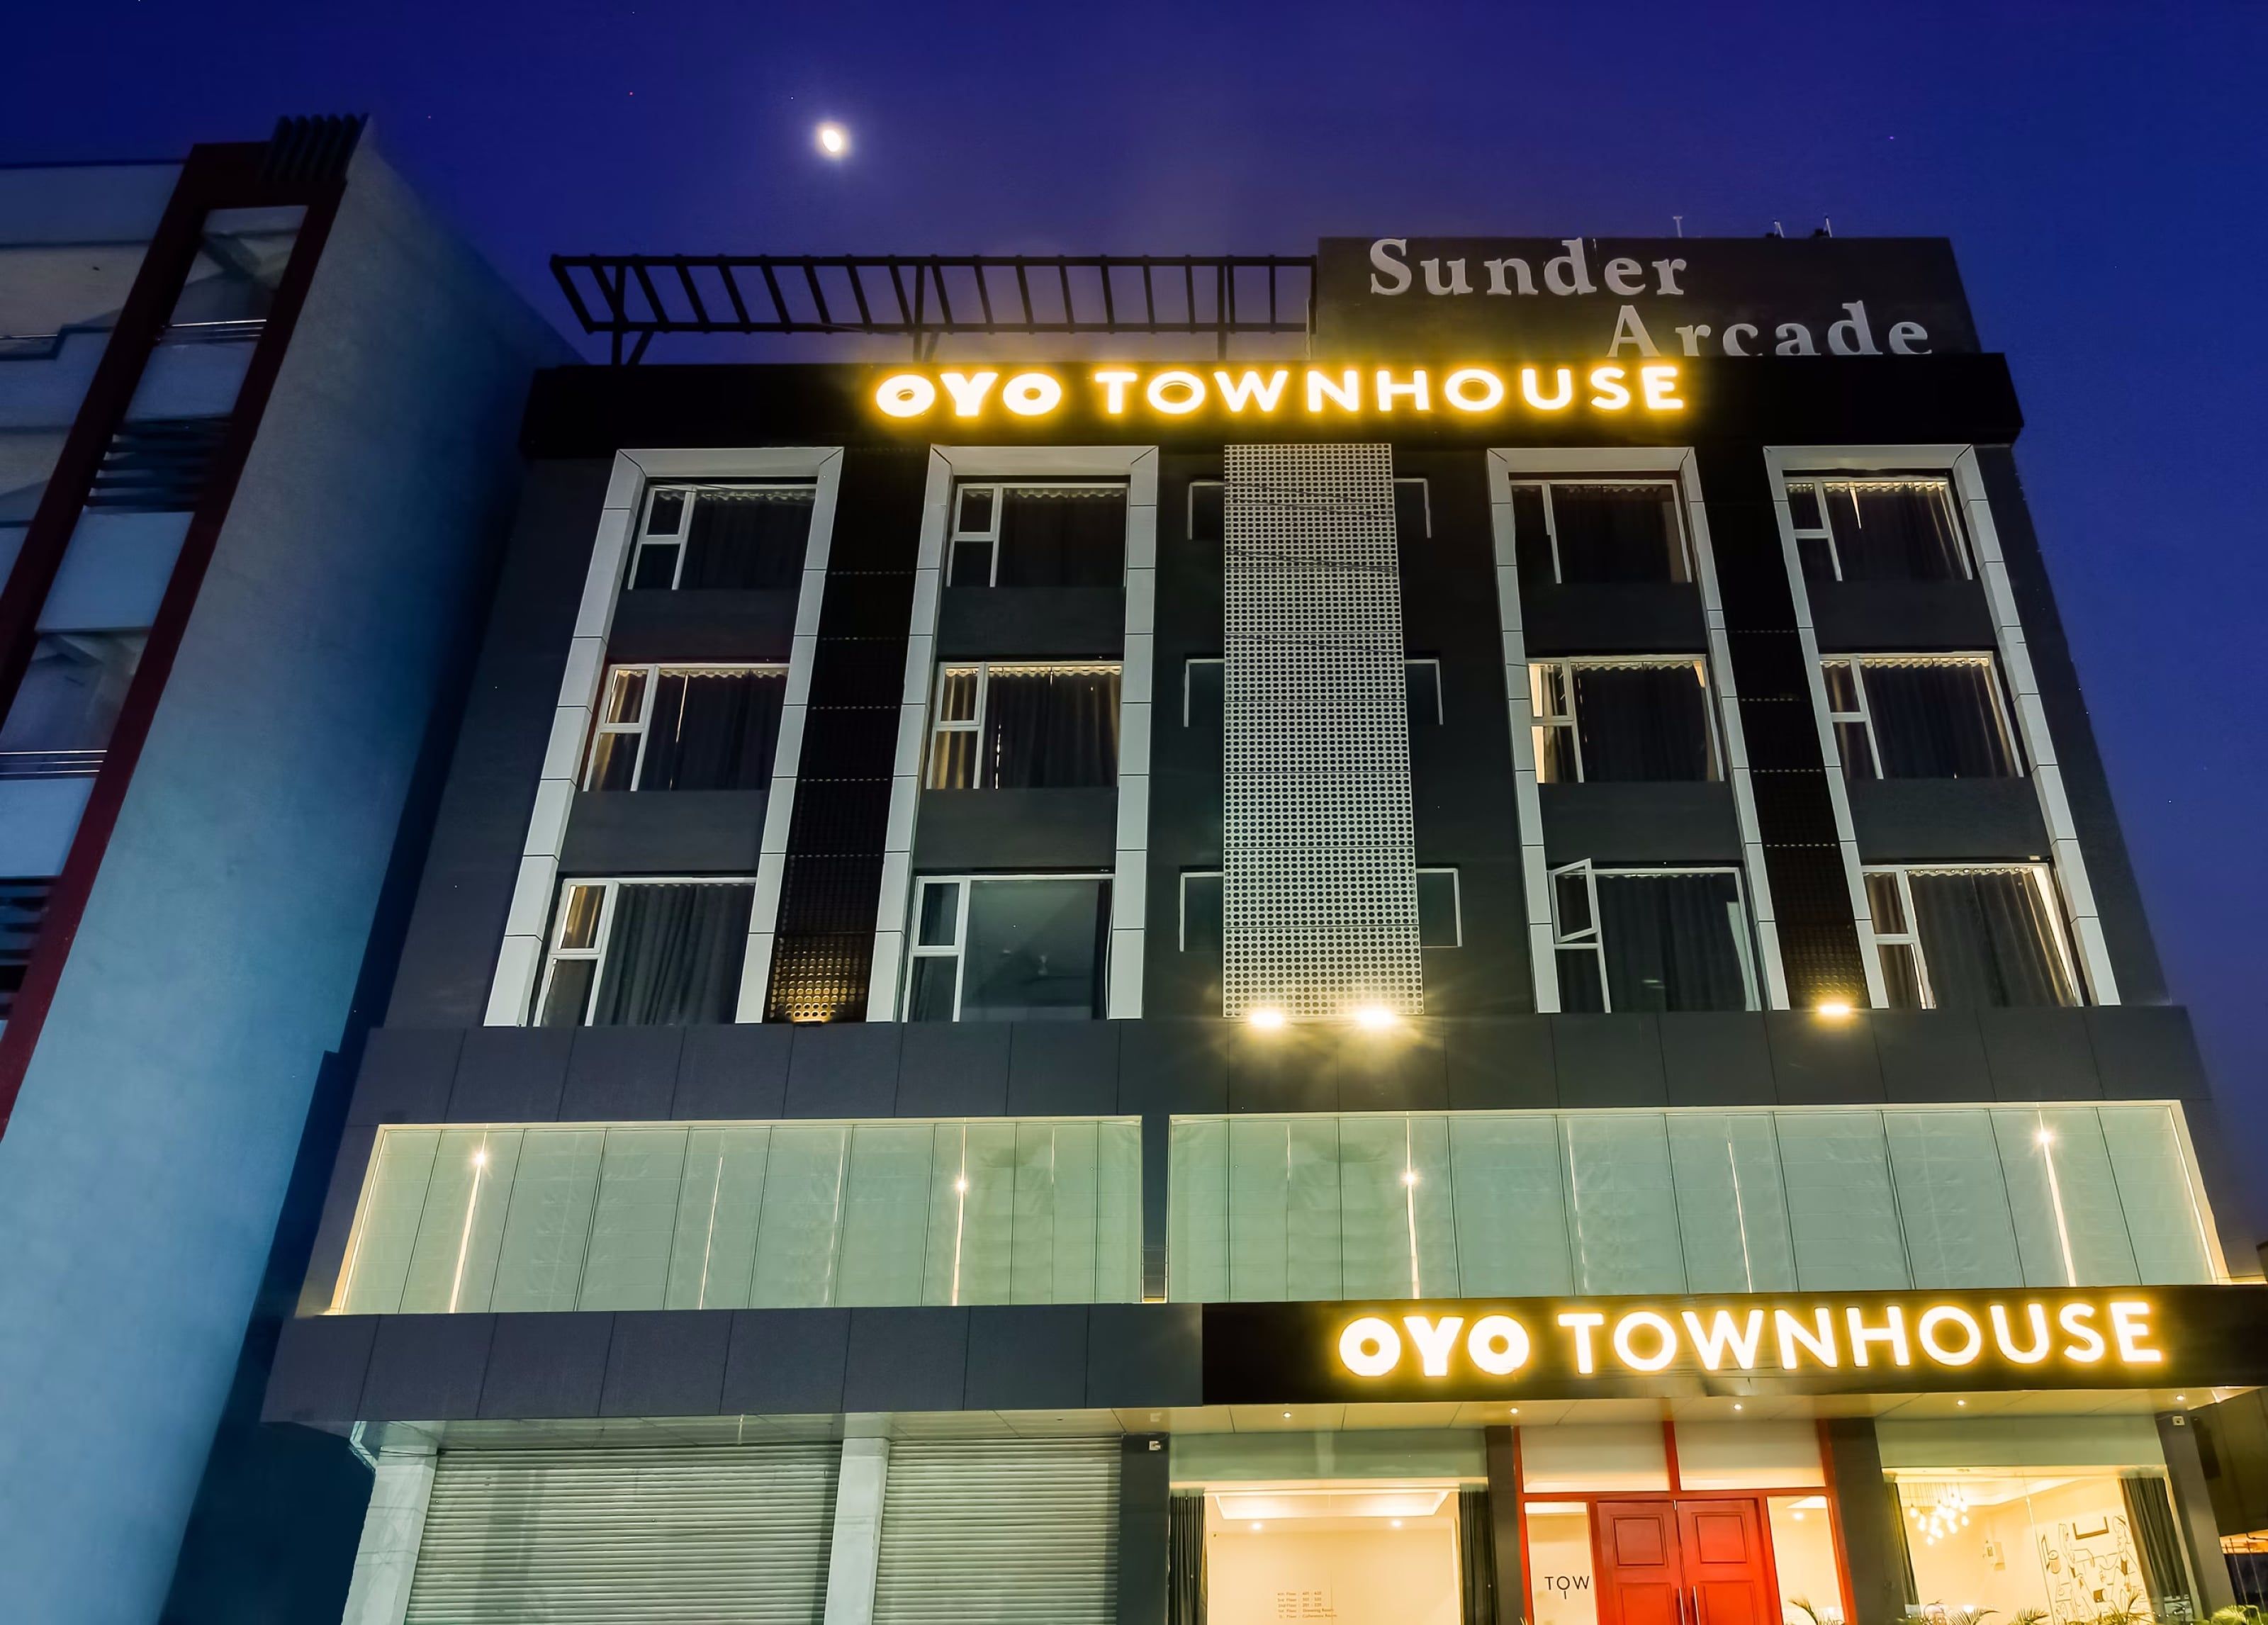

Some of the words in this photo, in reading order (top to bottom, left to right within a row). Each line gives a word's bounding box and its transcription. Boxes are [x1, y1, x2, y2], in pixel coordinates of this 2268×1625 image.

[1369, 237, 1687, 296] Sunder
[1605, 300, 1933, 358] Arcade
[875, 371, 1062, 418] OYO
[1094, 366, 1685, 415] TOWNHOUSE
[1338, 1315, 1530, 1377] OYO
[1557, 1302, 2162, 1374] TOWNHOUSE
